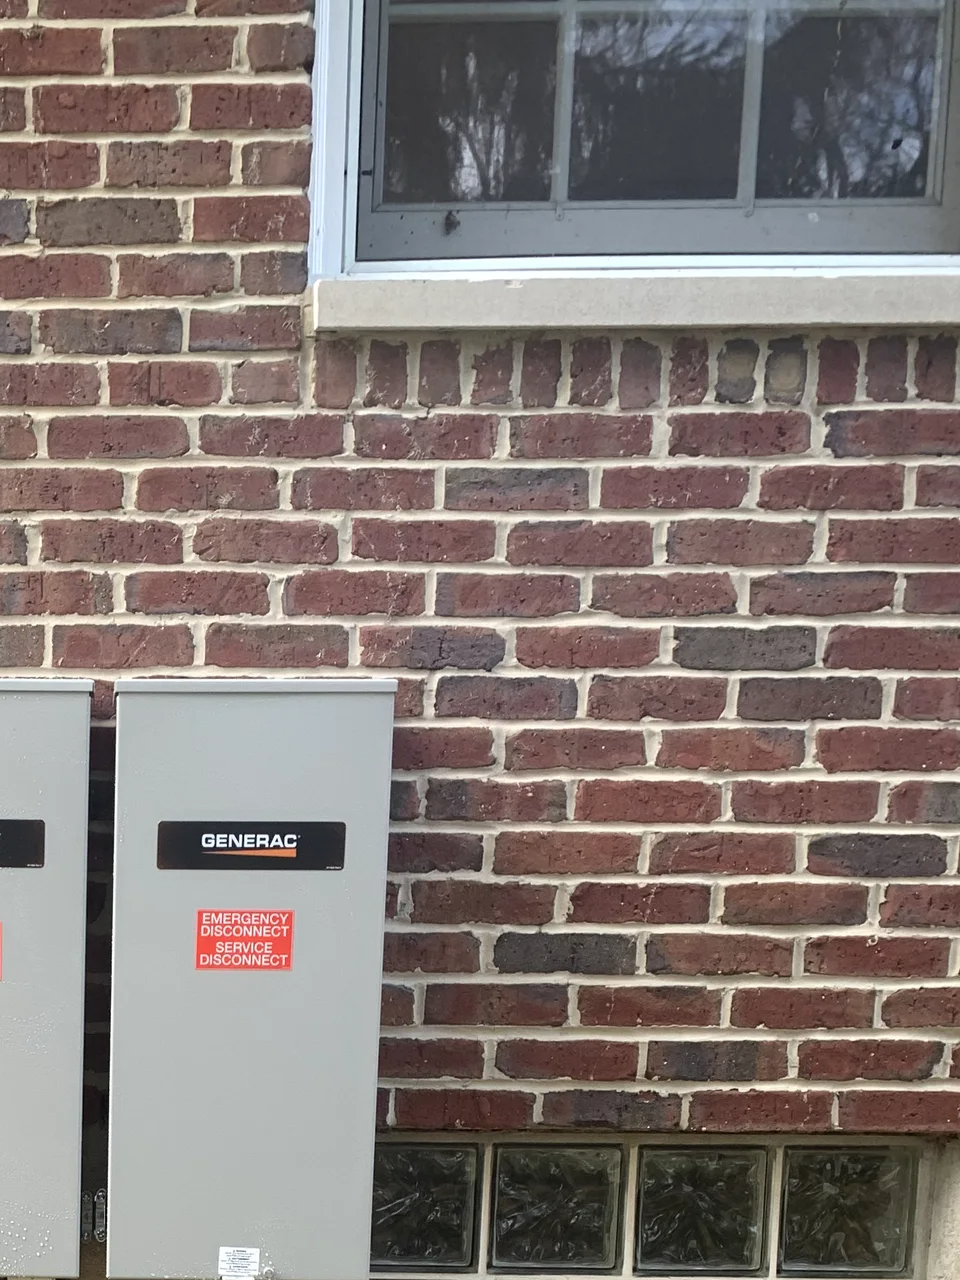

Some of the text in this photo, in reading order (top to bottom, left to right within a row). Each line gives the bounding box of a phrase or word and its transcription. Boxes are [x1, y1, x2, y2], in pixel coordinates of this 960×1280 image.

[201, 834, 297, 848] GENERAC
[202, 912, 289, 925] EMERGENCY
[200, 925, 289, 938] DISCONNECT
[216, 941, 273, 953] SERVICE
[200, 954, 288, 966] DISCONNECT
